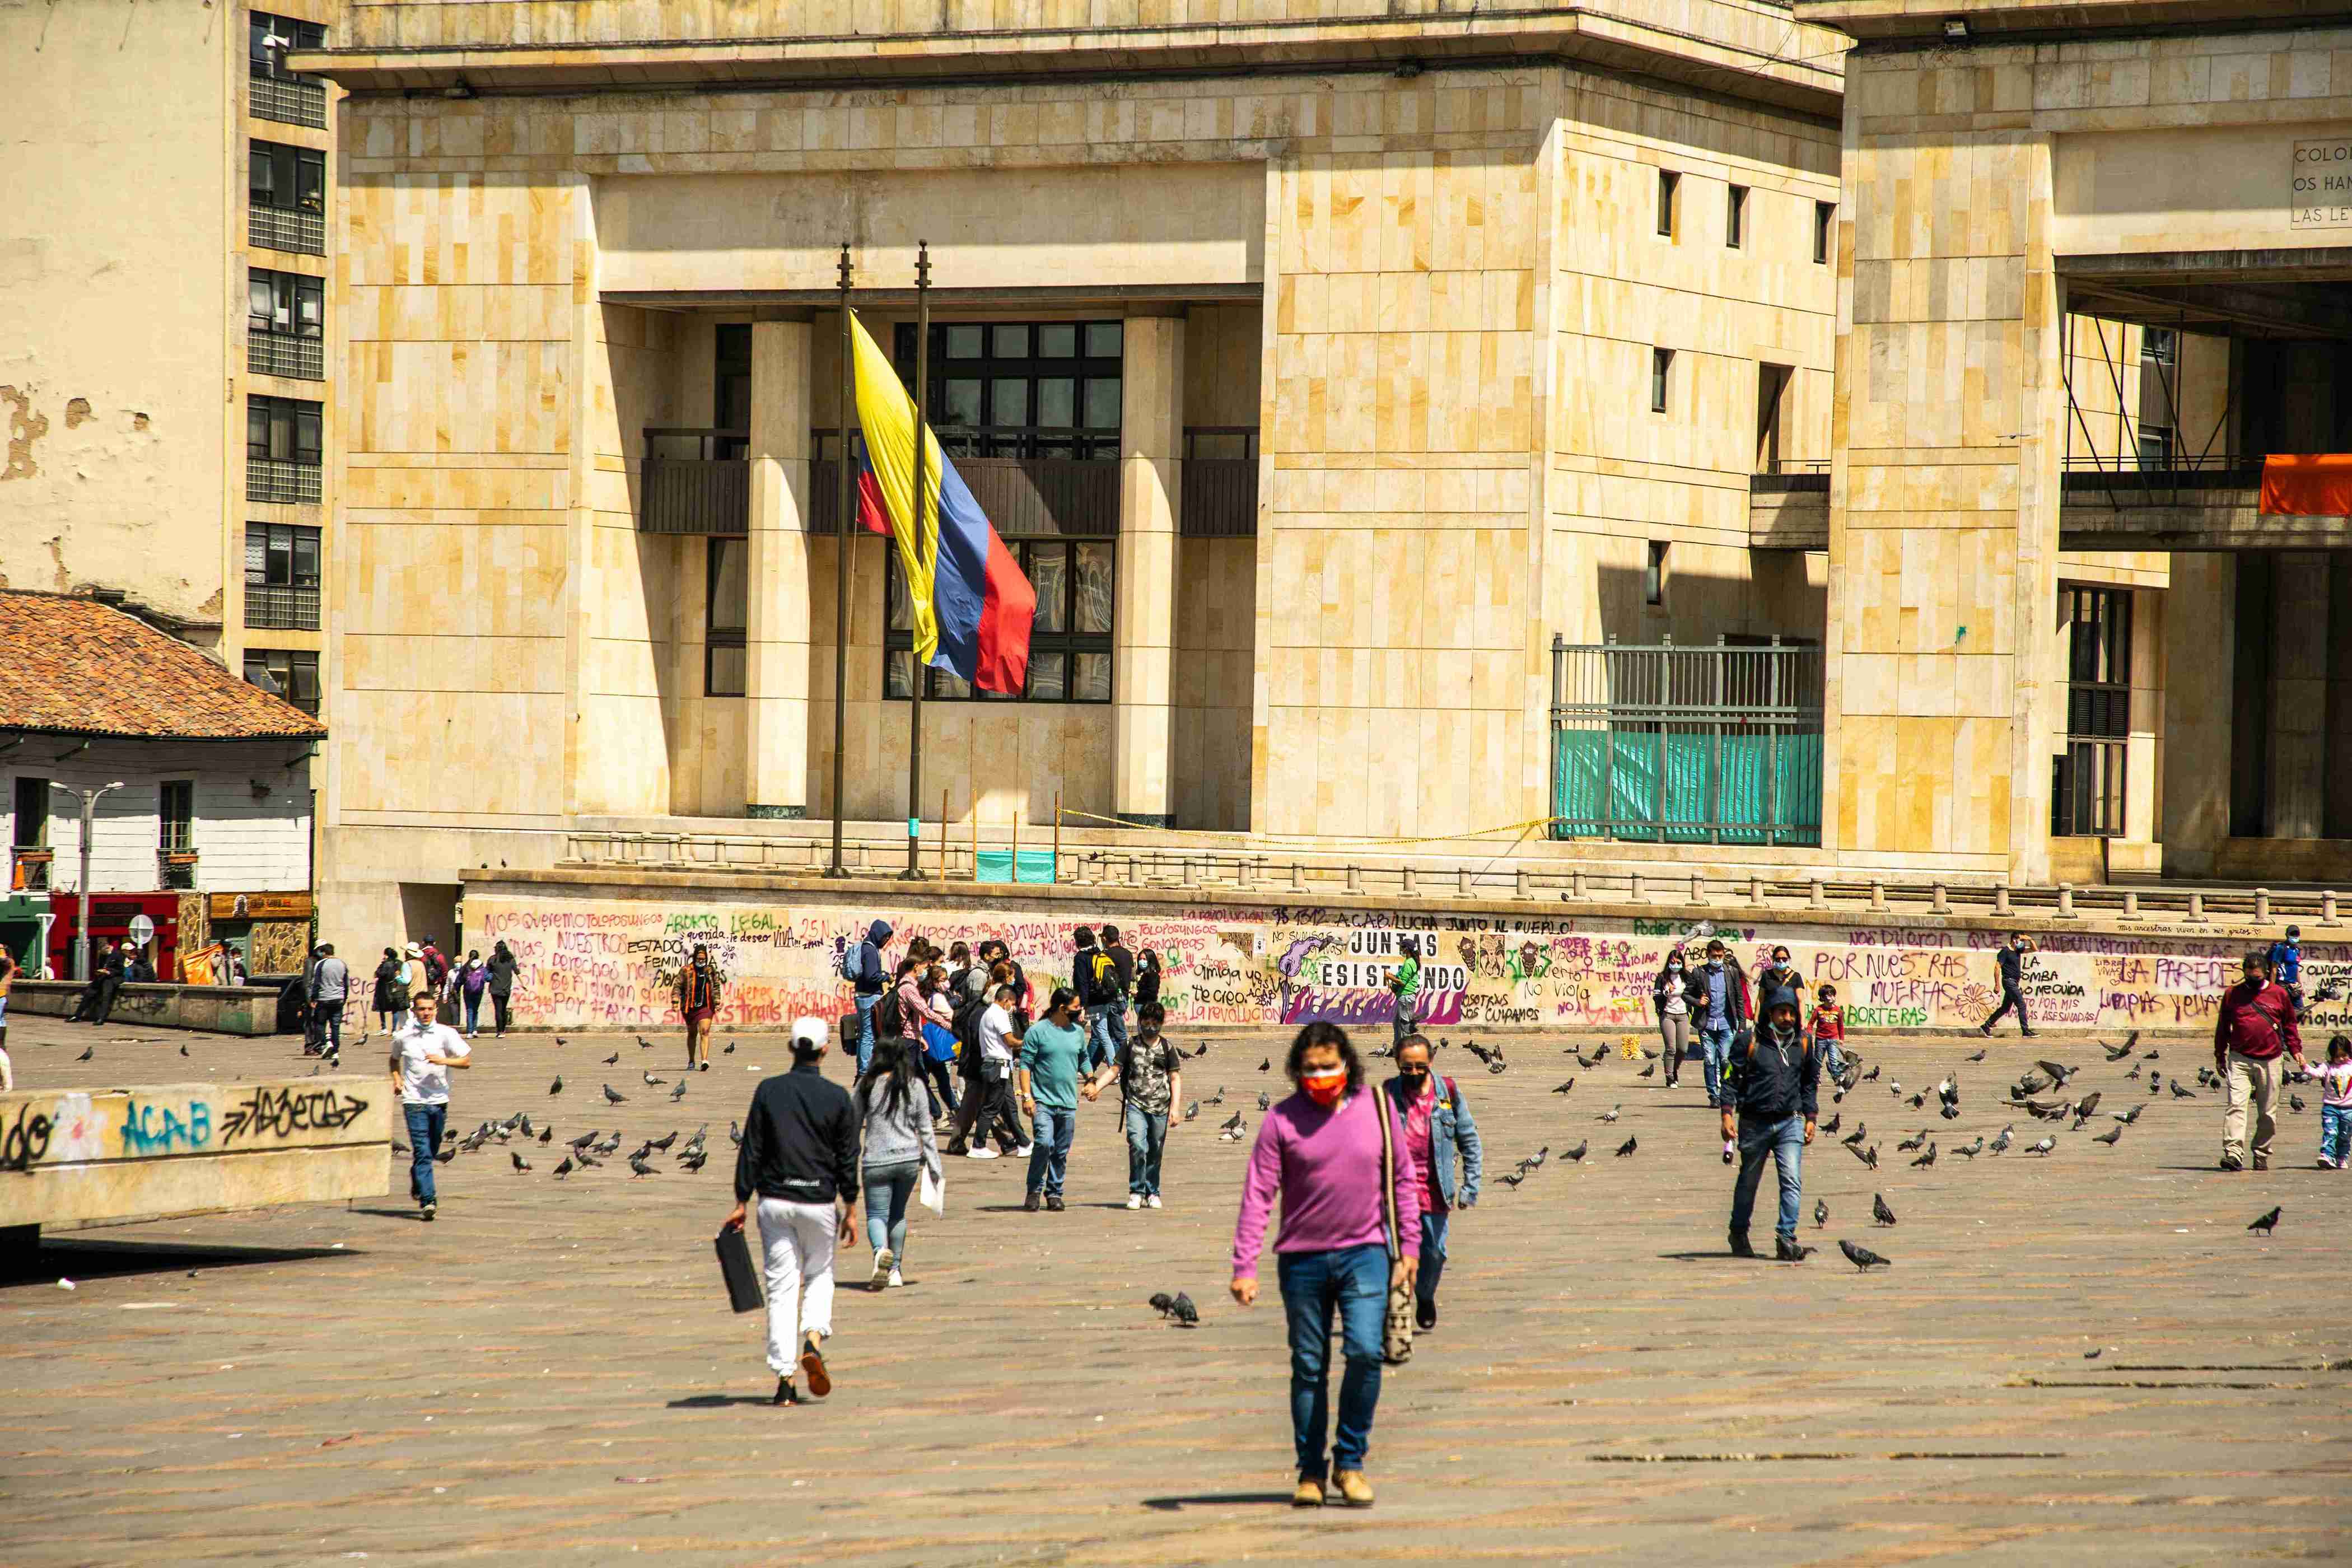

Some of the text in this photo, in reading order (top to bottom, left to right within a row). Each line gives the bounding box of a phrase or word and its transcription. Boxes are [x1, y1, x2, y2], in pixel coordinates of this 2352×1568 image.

[2295, 147, 2352, 162] COLO
[2294, 177, 2317, 191] OS
[2293, 208, 2322, 222] LAS
[1272, 931, 1285, 944] NO
[2022, 956, 2040, 969] LA
[2061, 998, 2080, 1009] MIS
[119, 1099, 214, 1156] ACAB
